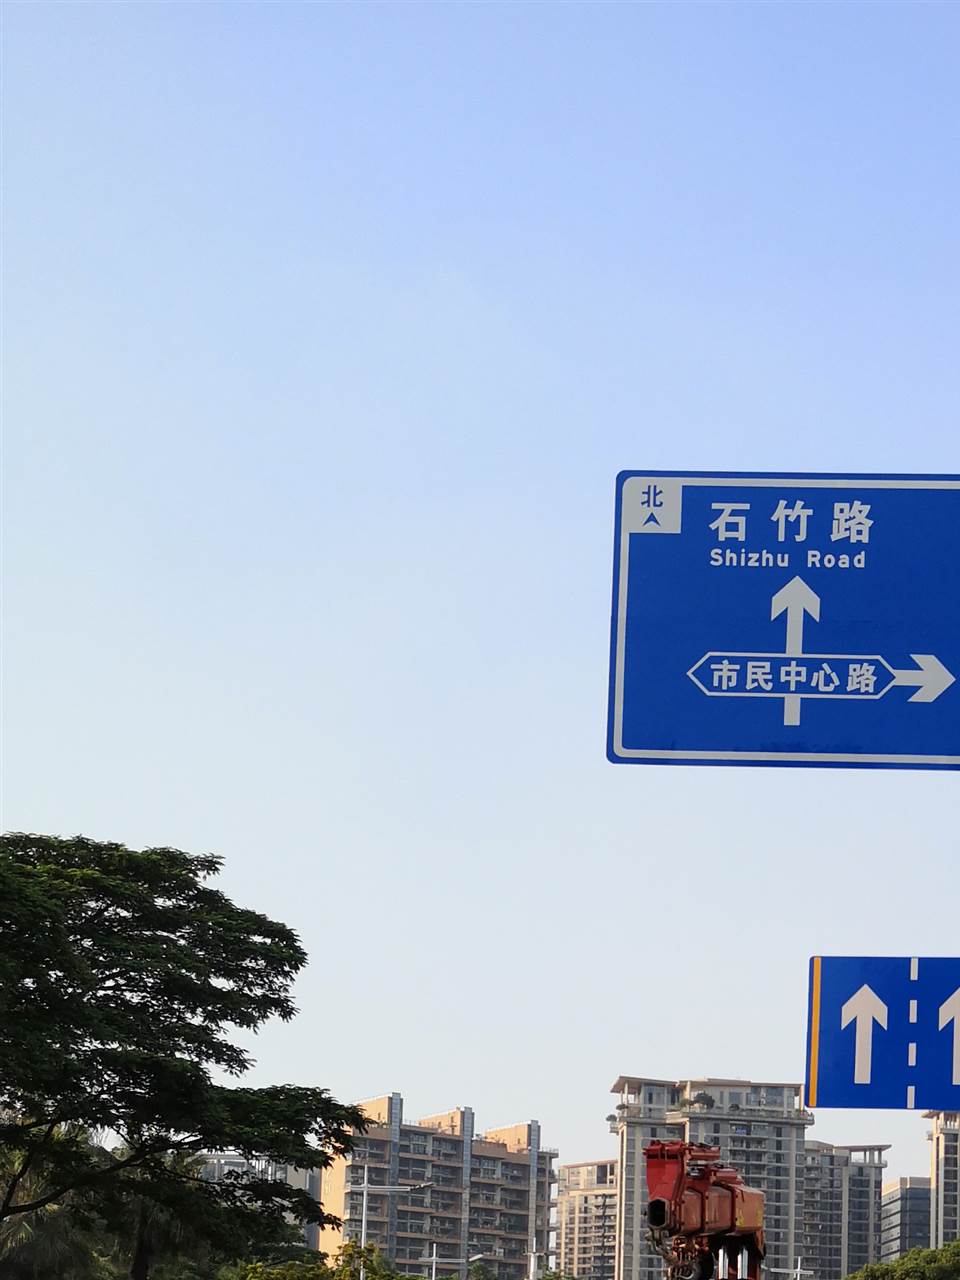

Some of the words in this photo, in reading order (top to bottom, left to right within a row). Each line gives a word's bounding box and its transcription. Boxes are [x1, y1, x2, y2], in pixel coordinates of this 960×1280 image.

[641, 485, 664, 508] 北
[708, 499, 875, 544] 石竹路
[709, 549, 789, 567] Shizhu
[807, 550, 866, 568] Road
[710, 659, 877, 693] 市民中心路
